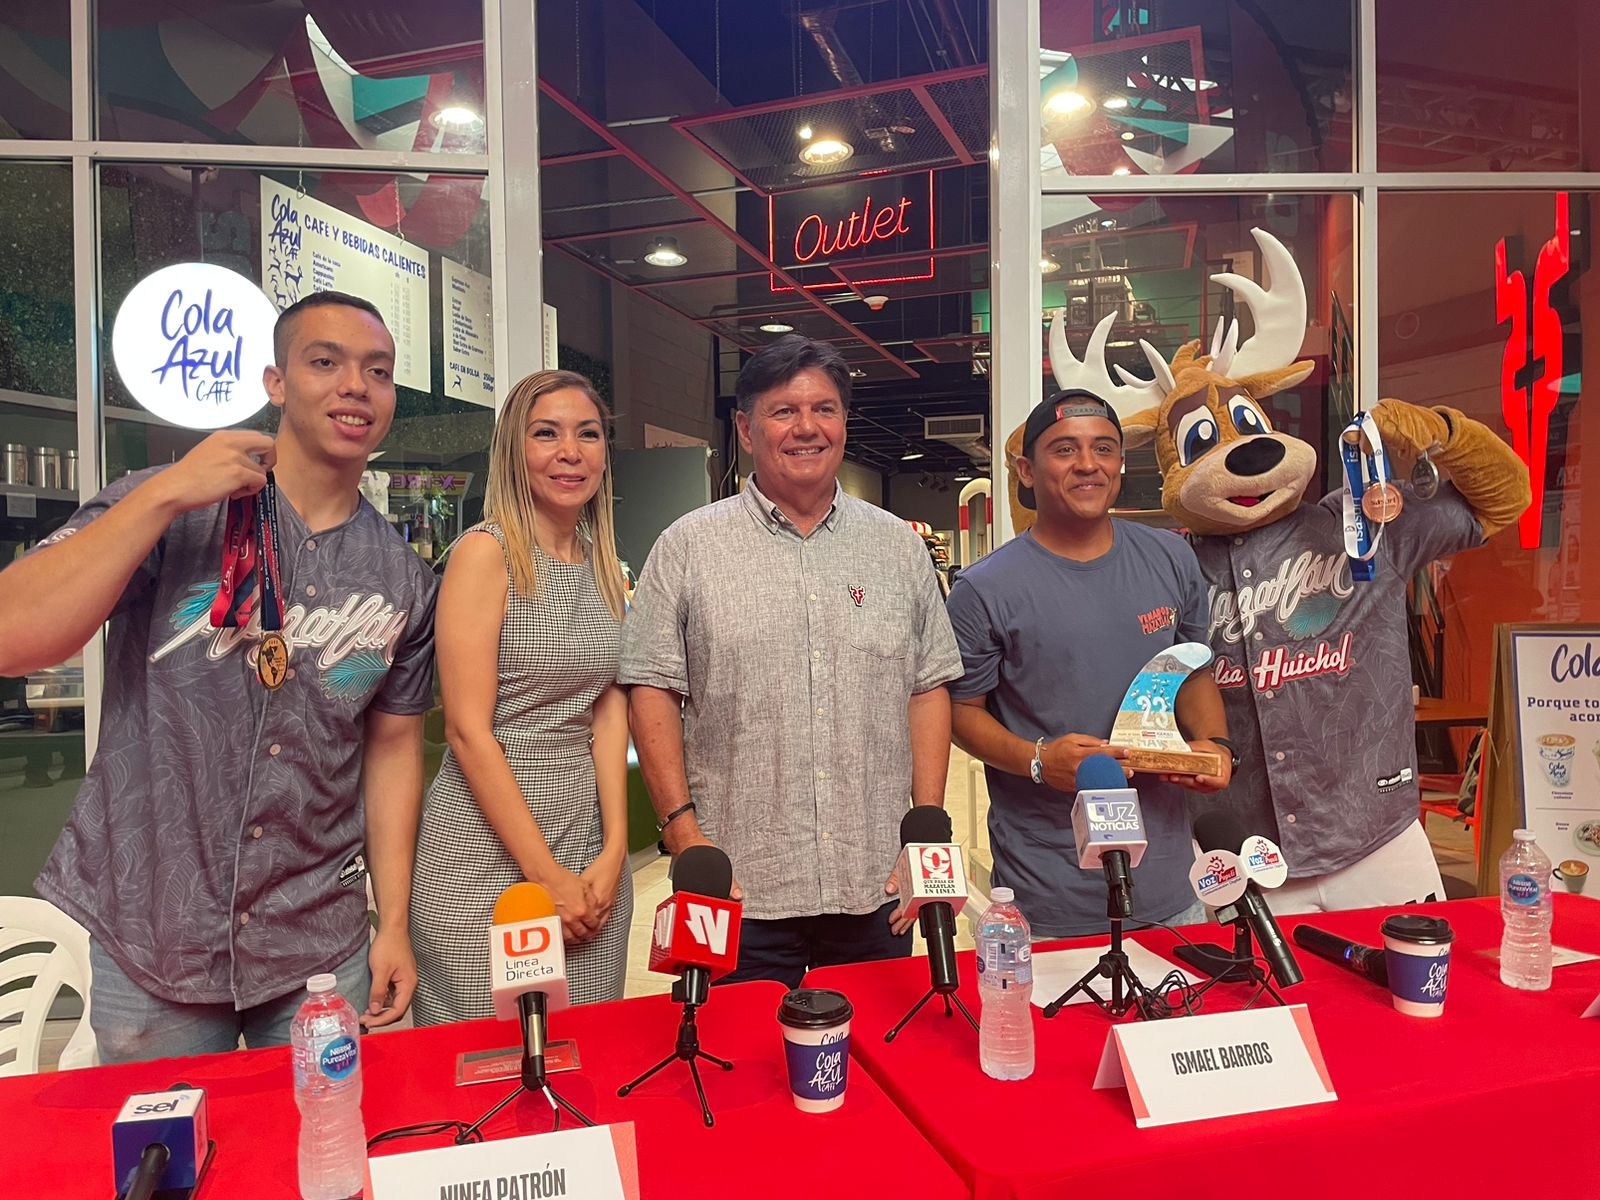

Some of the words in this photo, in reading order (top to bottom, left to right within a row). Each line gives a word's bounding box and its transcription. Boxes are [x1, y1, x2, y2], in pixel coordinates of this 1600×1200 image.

[271, 194, 299, 226] Cola
[269, 221, 301, 253] Azul
[794, 196, 912, 261] Outlet
[304, 214, 329, 237] CAFÉ
[332, 226, 340, 241] Y
[342, 231, 380, 259] BEBIDAS
[381, 248, 426, 279] CALIENTES
[161, 288, 235, 341] Cola
[152, 335, 243, 399] Azul
[1252, 632, 1352, 689] Huichol
[1527, 697, 1580, 710] Porque
[1086, 802, 1139, 822] LUZ
[1090, 821, 1140, 831] NOTICIAS
[1250, 856, 1264, 866] Voz
[1199, 877, 1217, 889] Voz
[506, 966, 554, 981] Directa
[816, 1051, 842, 1070] Cola
[1171, 1047, 1220, 1076] ISMAEL
[1219, 1041, 1274, 1069] BARROS
[134, 1099, 179, 1115] sel
[496, 1163, 566, 1200] PATRÓN
